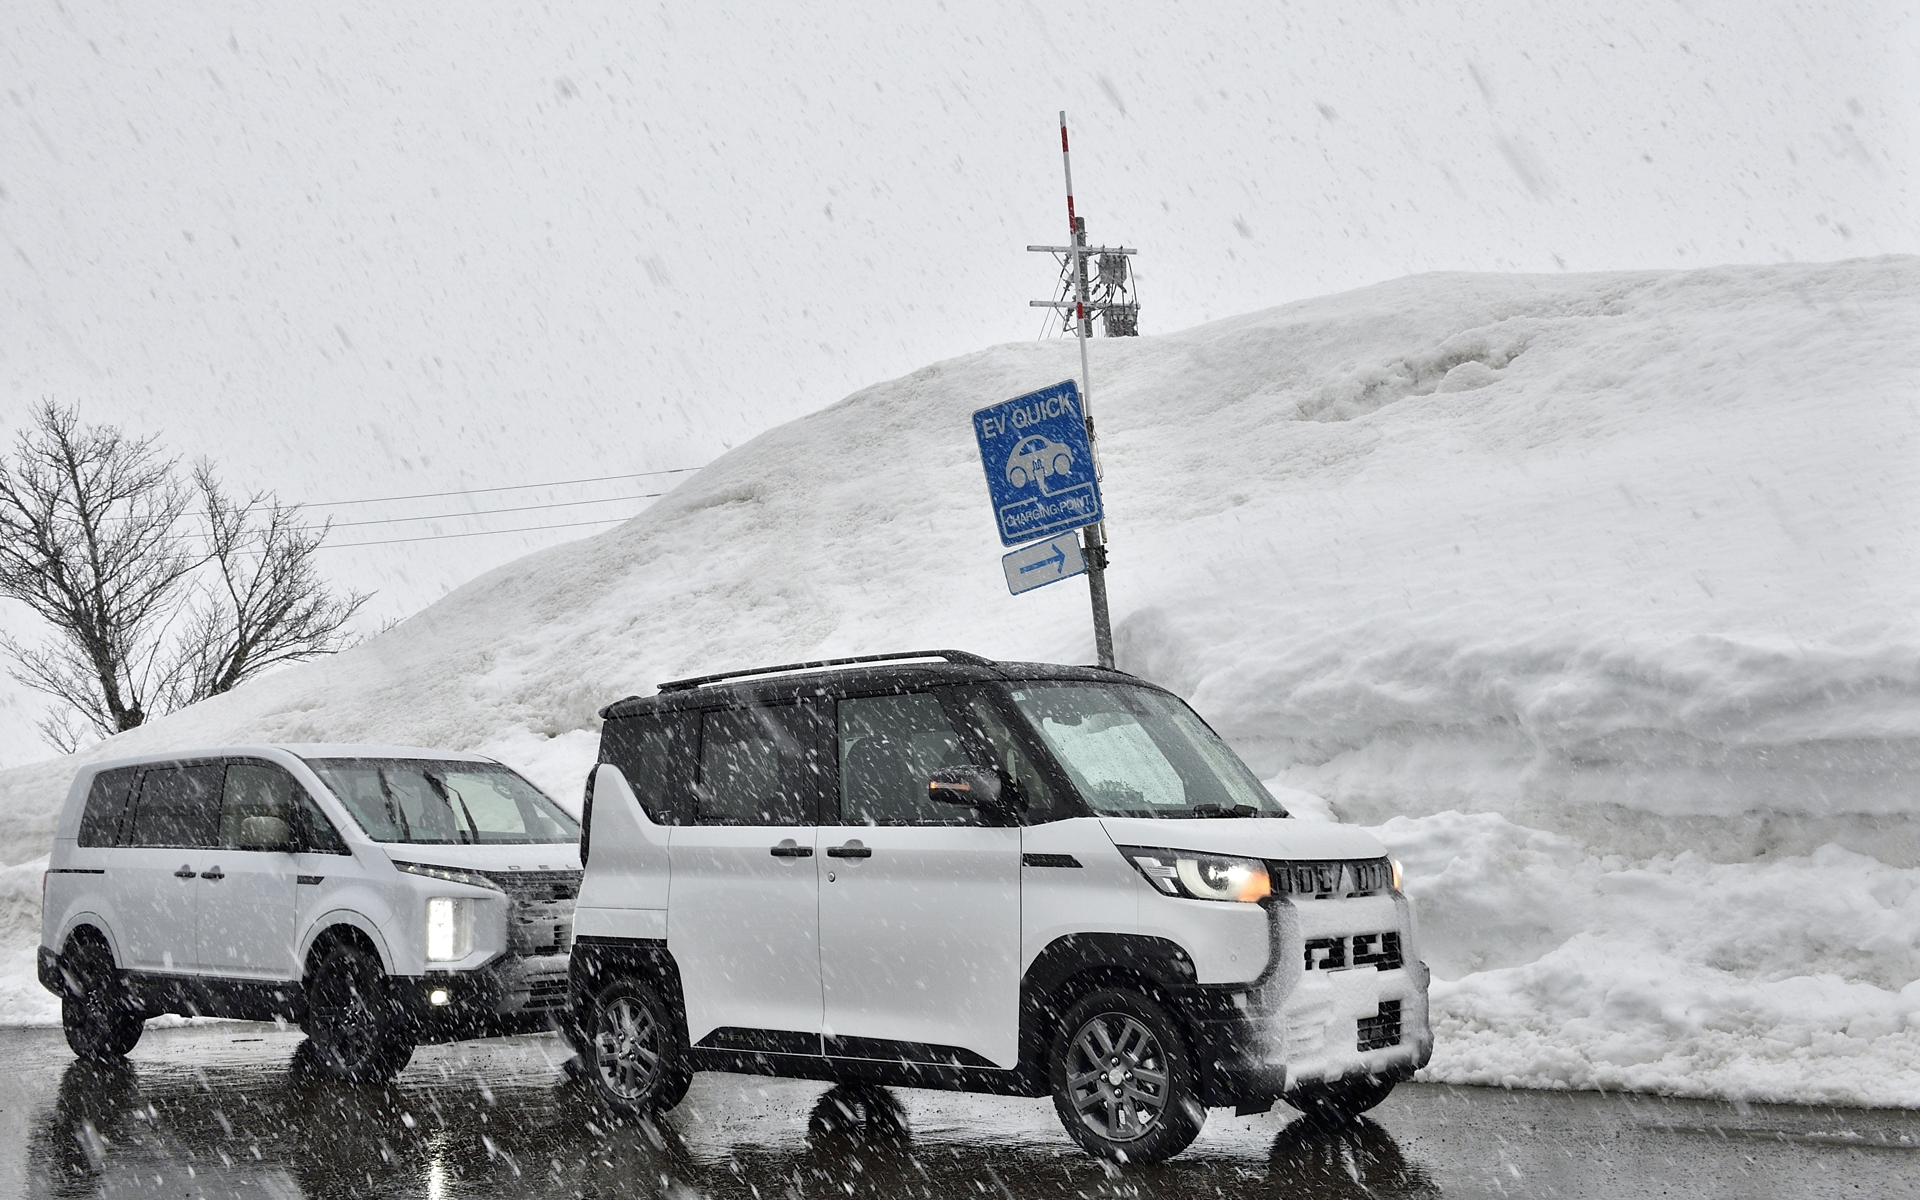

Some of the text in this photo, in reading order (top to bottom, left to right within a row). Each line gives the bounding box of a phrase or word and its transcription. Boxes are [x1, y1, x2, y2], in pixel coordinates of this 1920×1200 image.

[982, 392, 1074, 439] EV QUICK
[1006, 494, 1090, 526] CHARGING POINT
